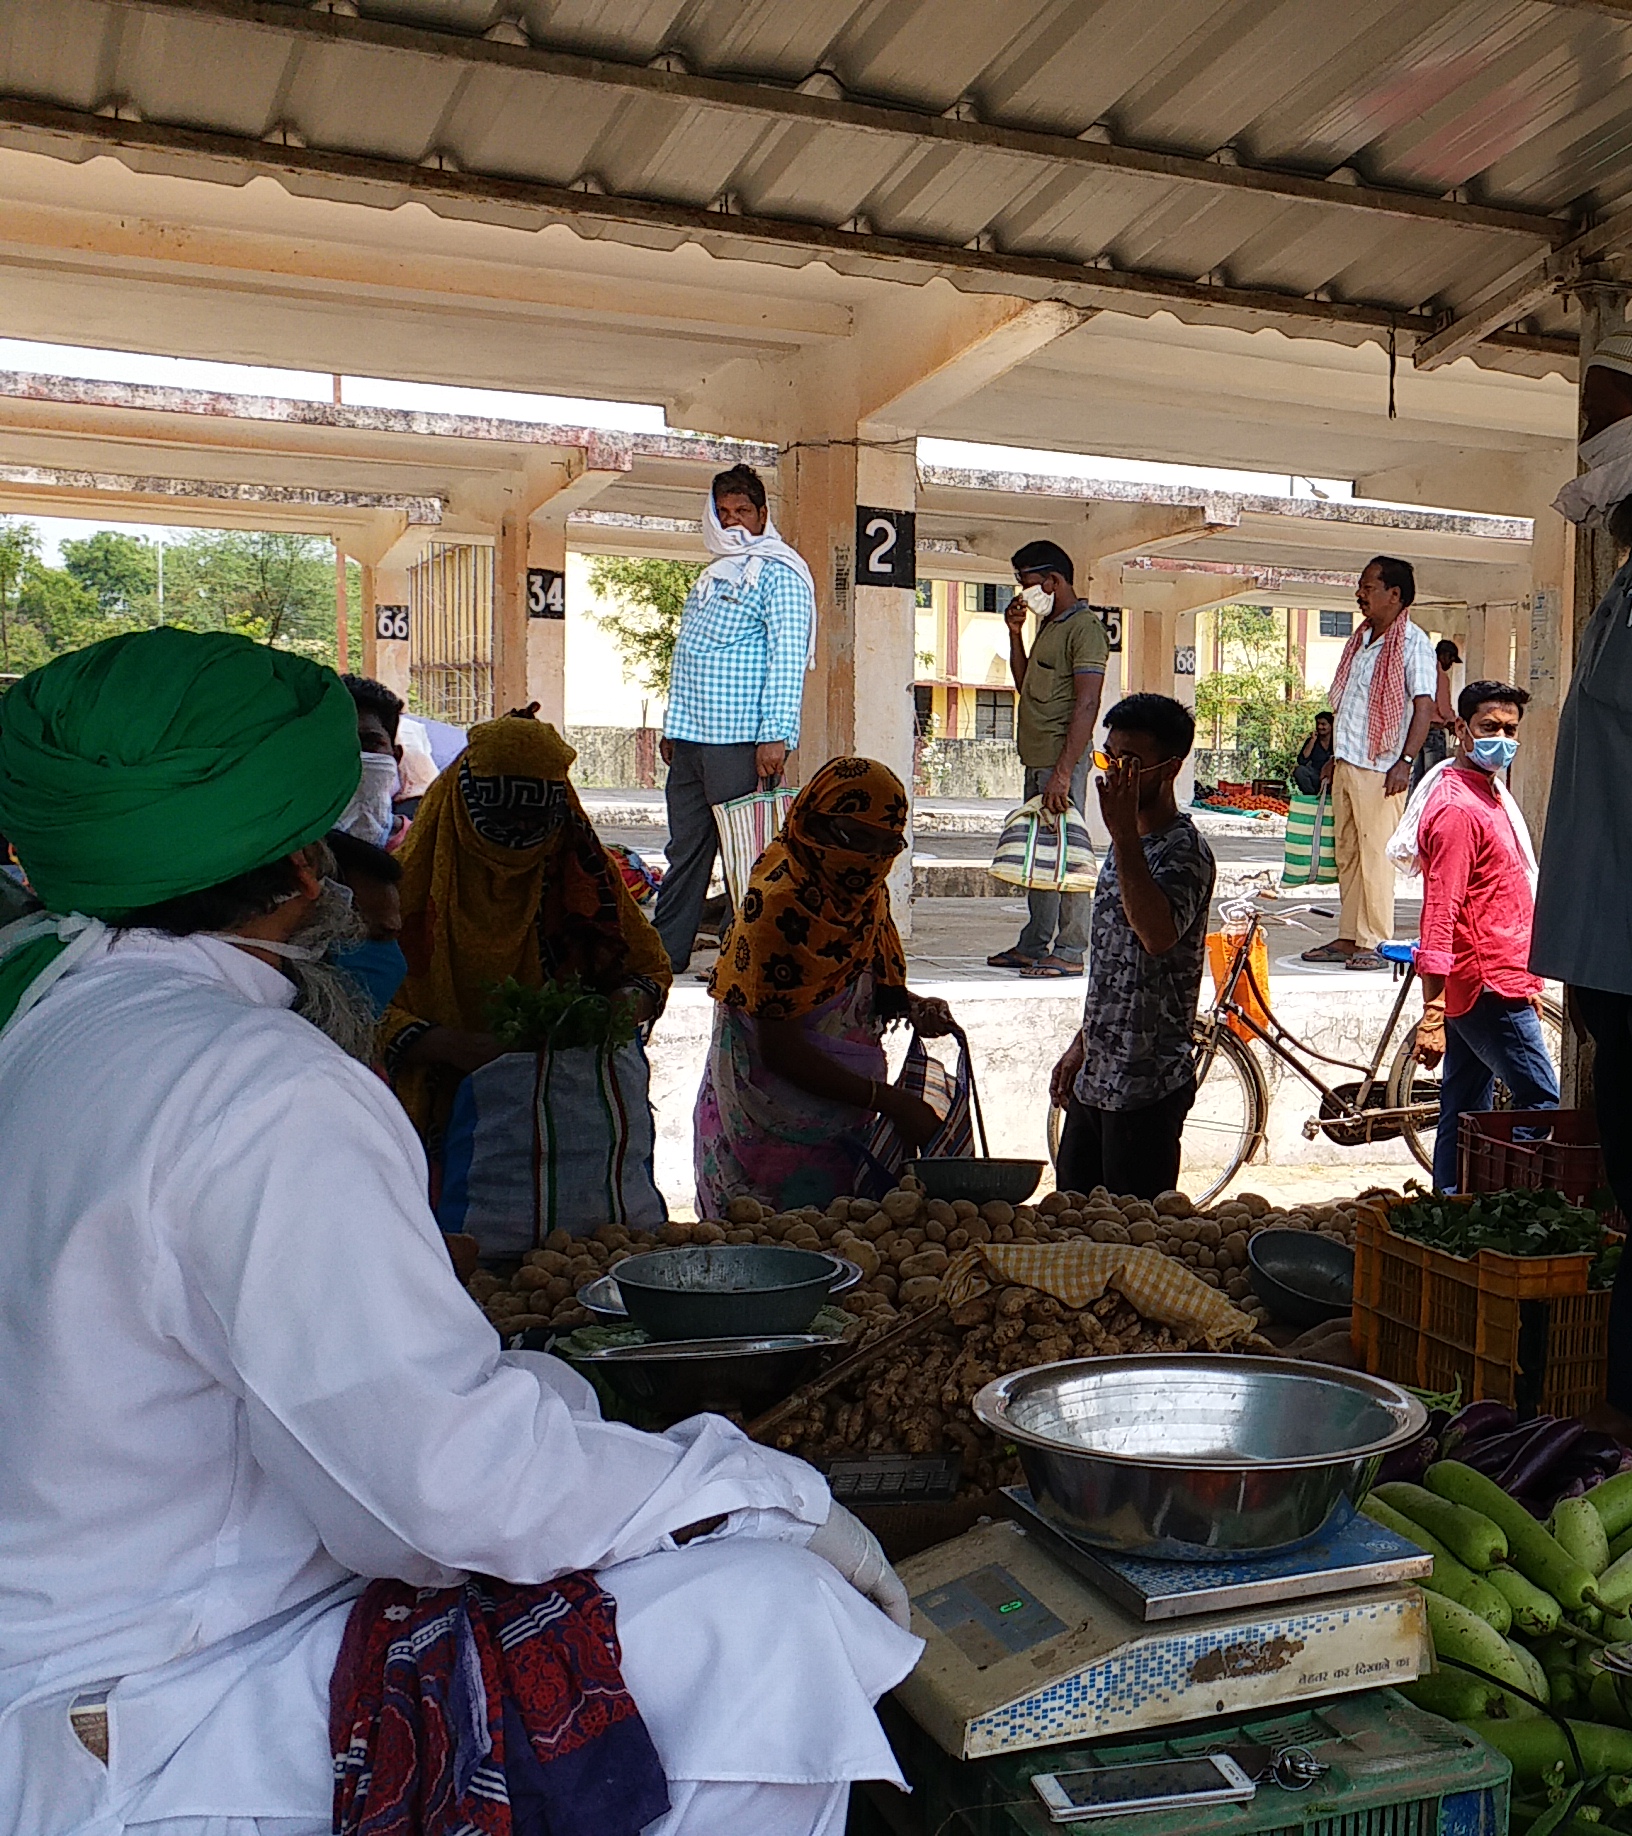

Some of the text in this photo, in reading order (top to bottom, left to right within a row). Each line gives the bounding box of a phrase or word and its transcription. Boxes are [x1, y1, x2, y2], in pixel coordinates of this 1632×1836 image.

[866, 518, 897, 572] 2
[528, 575, 563, 612] 34
[378, 610, 407, 637] 66
[1098, 611, 1121, 645] 5
[1176, 650, 1195, 672] 68
